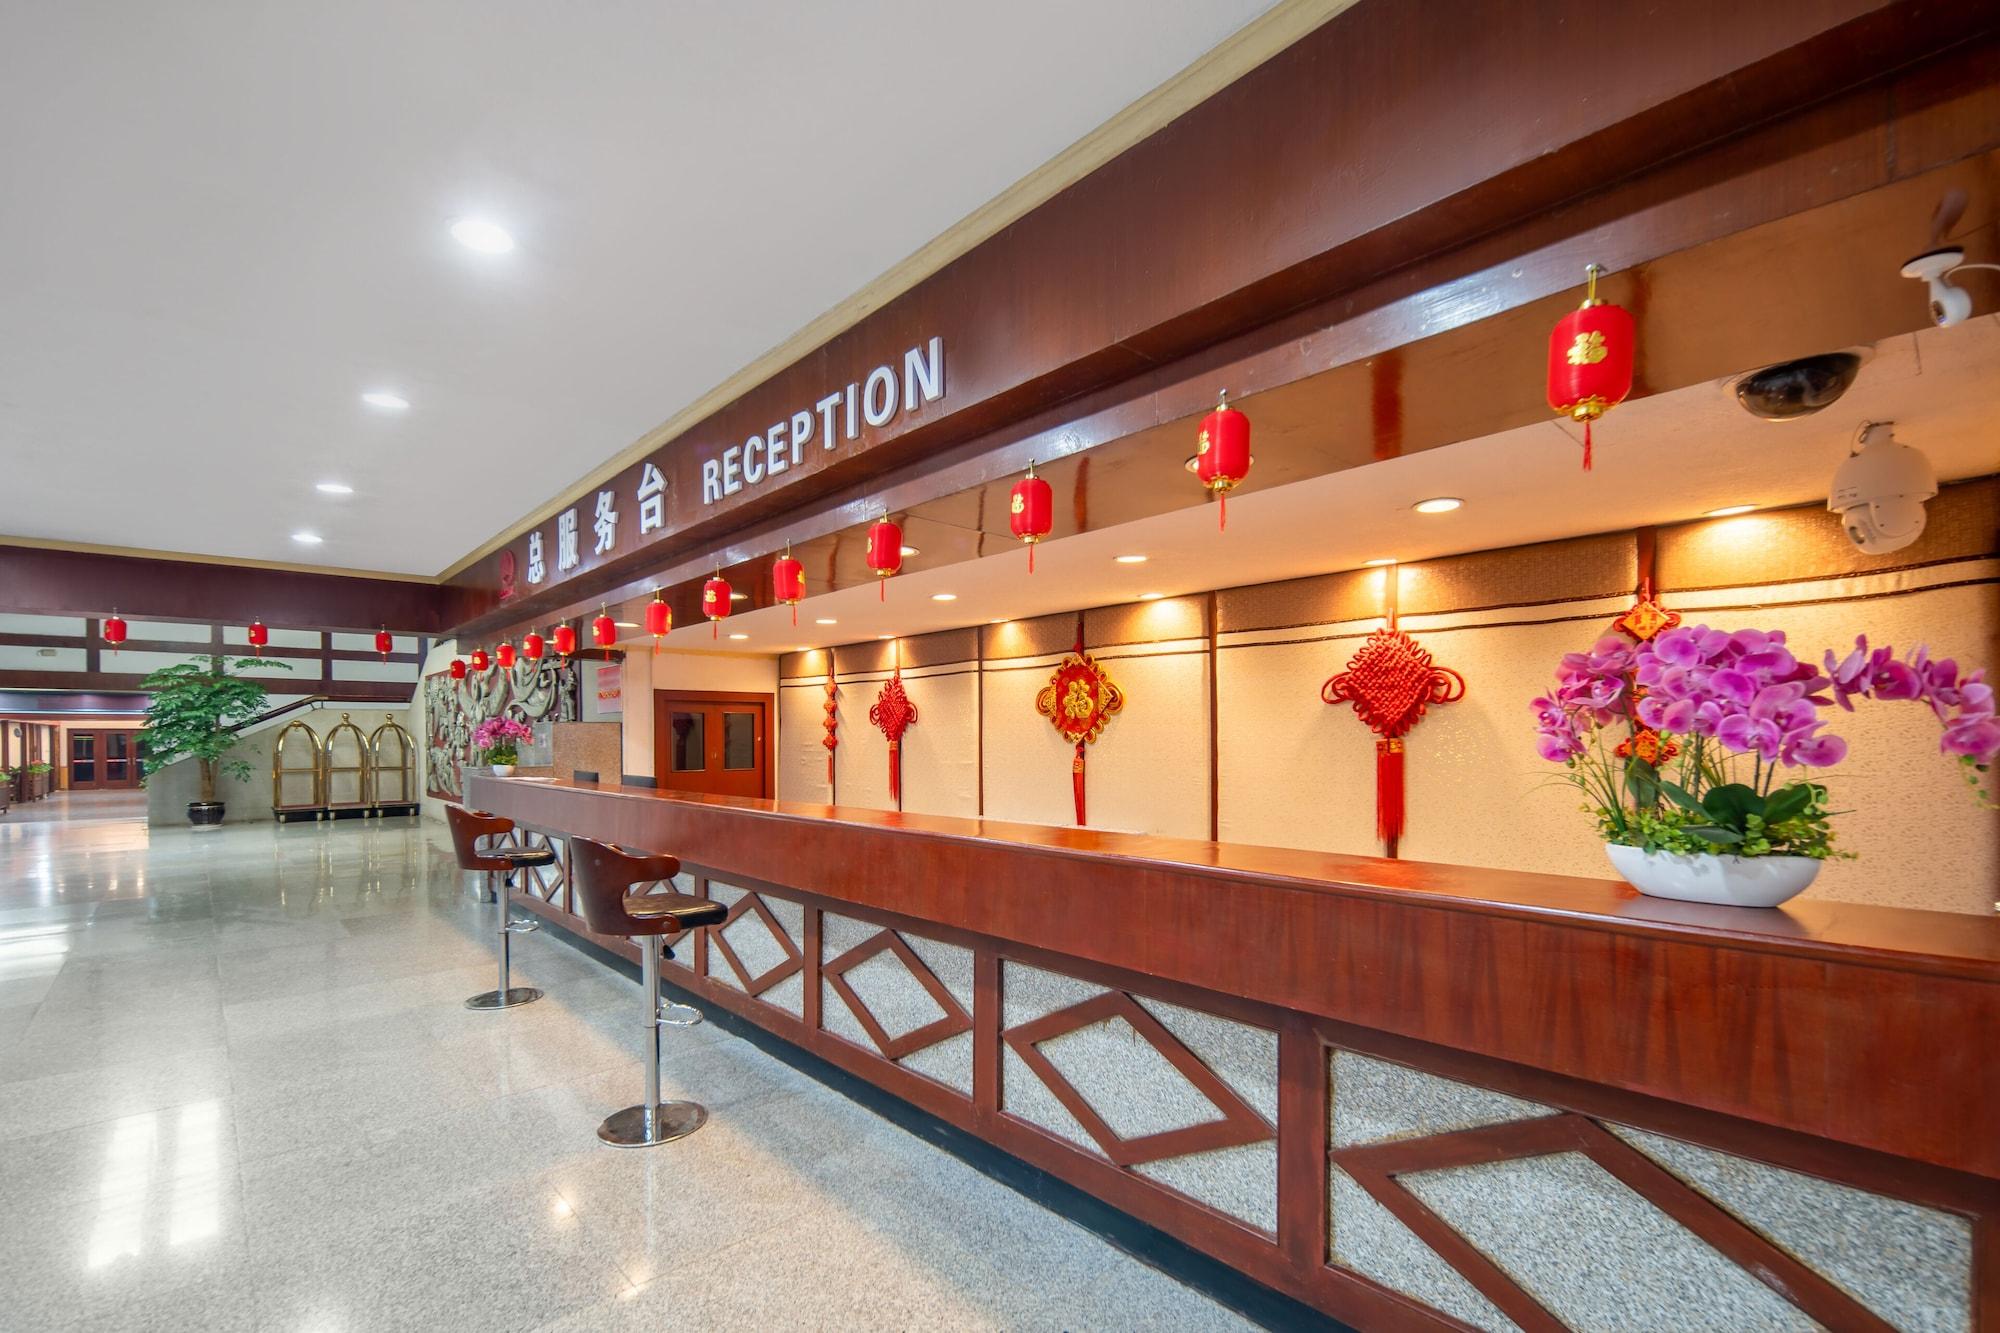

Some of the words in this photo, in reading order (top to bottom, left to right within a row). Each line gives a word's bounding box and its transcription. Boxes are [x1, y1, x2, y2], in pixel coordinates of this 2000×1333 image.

[702, 336, 945, 505] RECEPTION
[527, 462, 669, 584] 总服务台
